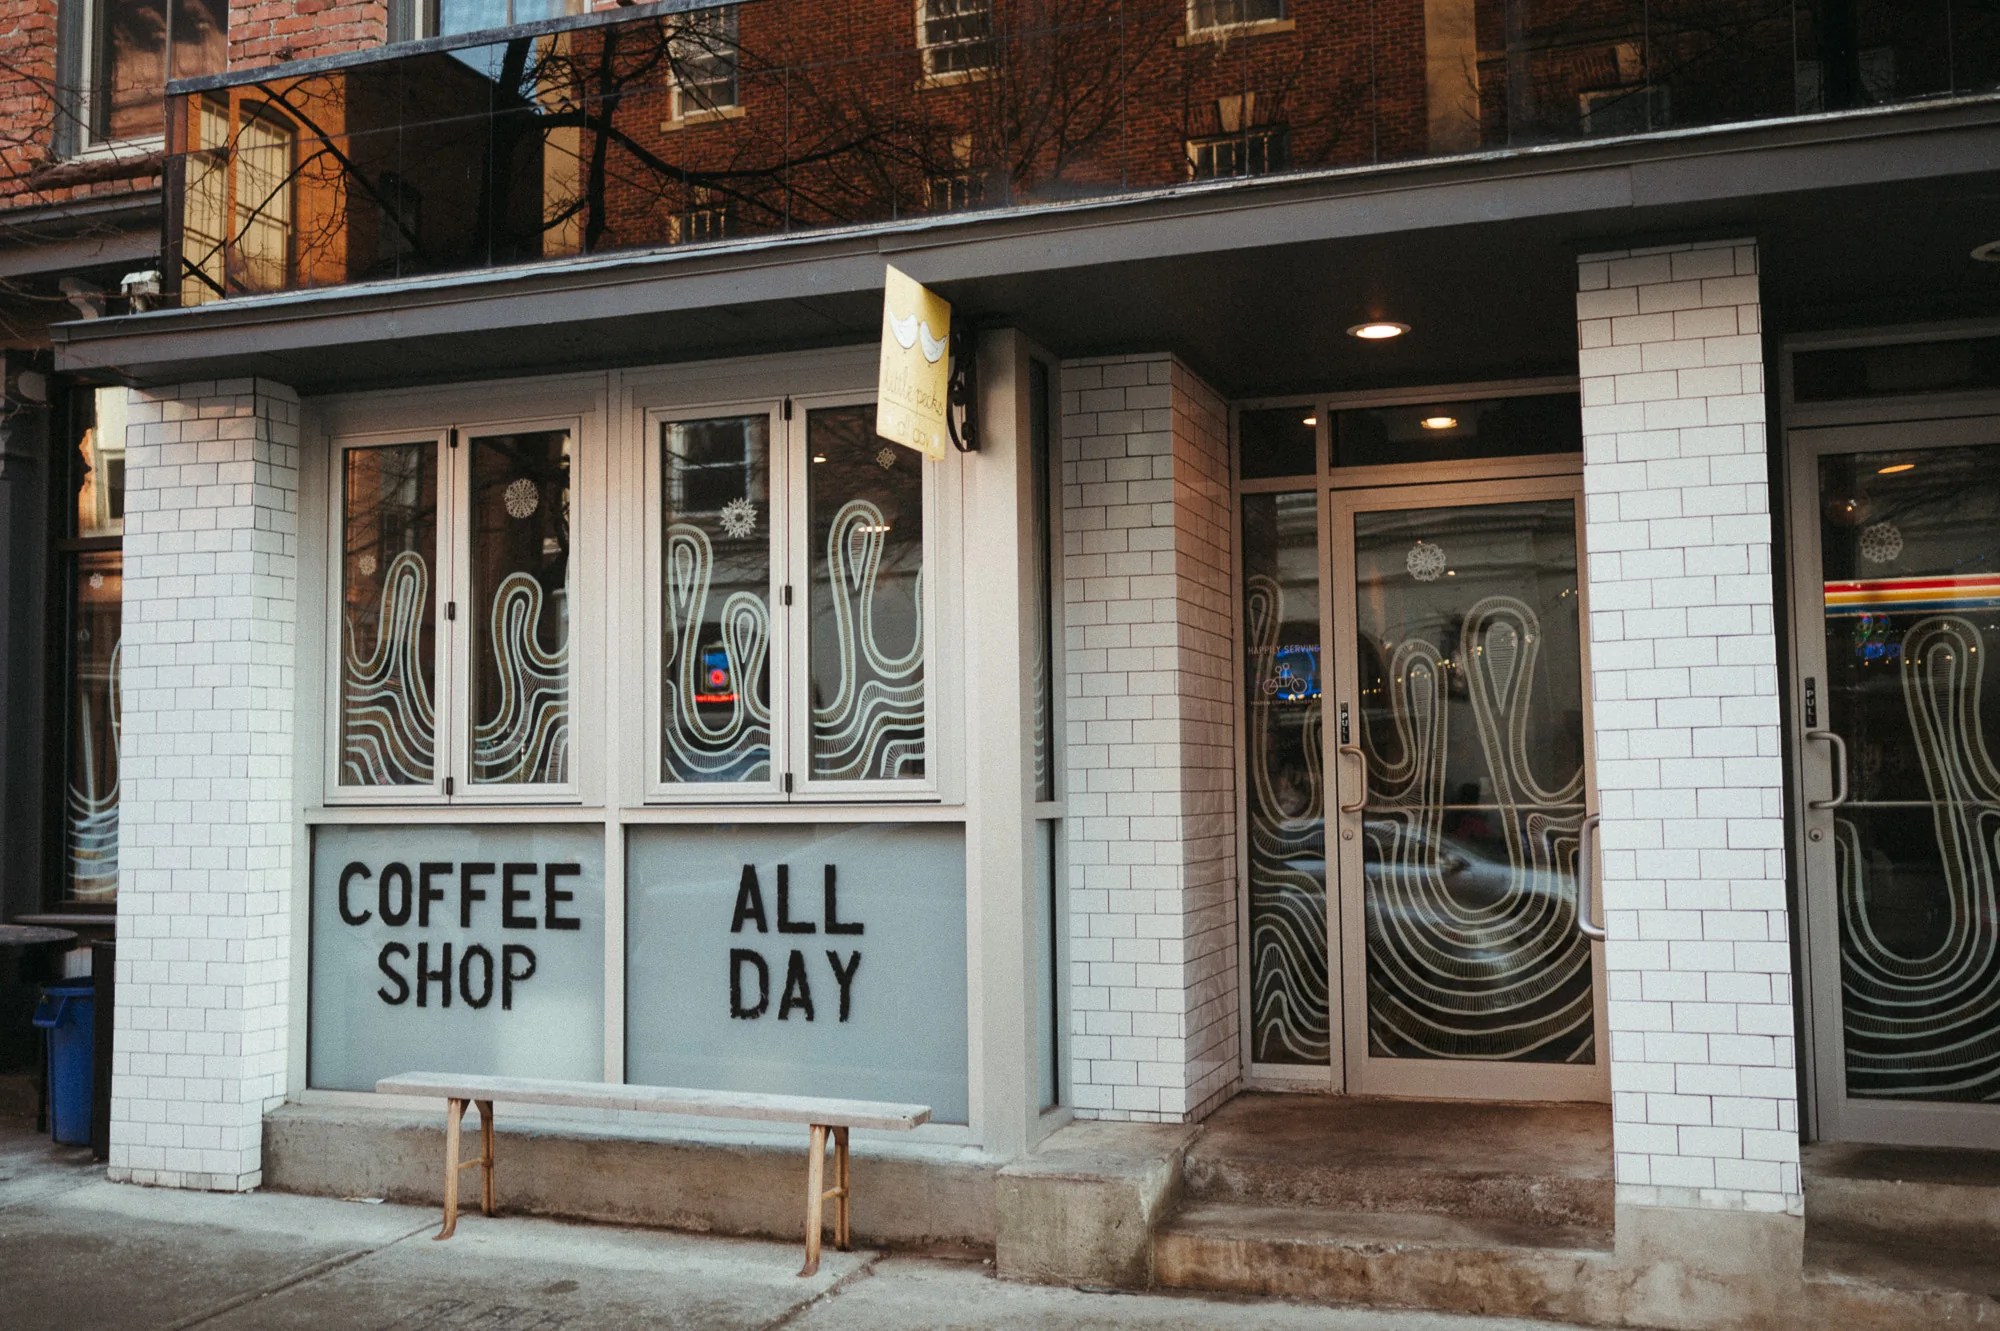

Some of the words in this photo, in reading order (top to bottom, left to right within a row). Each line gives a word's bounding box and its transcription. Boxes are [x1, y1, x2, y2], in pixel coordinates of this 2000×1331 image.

[1248, 645, 1281, 655] HAPPILY
[1283, 644, 1321, 654] SERVING
[1806, 690, 1815, 725] PULL
[338, 861, 581, 930] COFFEE
[730, 864, 865, 934] ALL
[377, 942, 537, 1010] SHOP
[730, 948, 862, 1023] DAY
